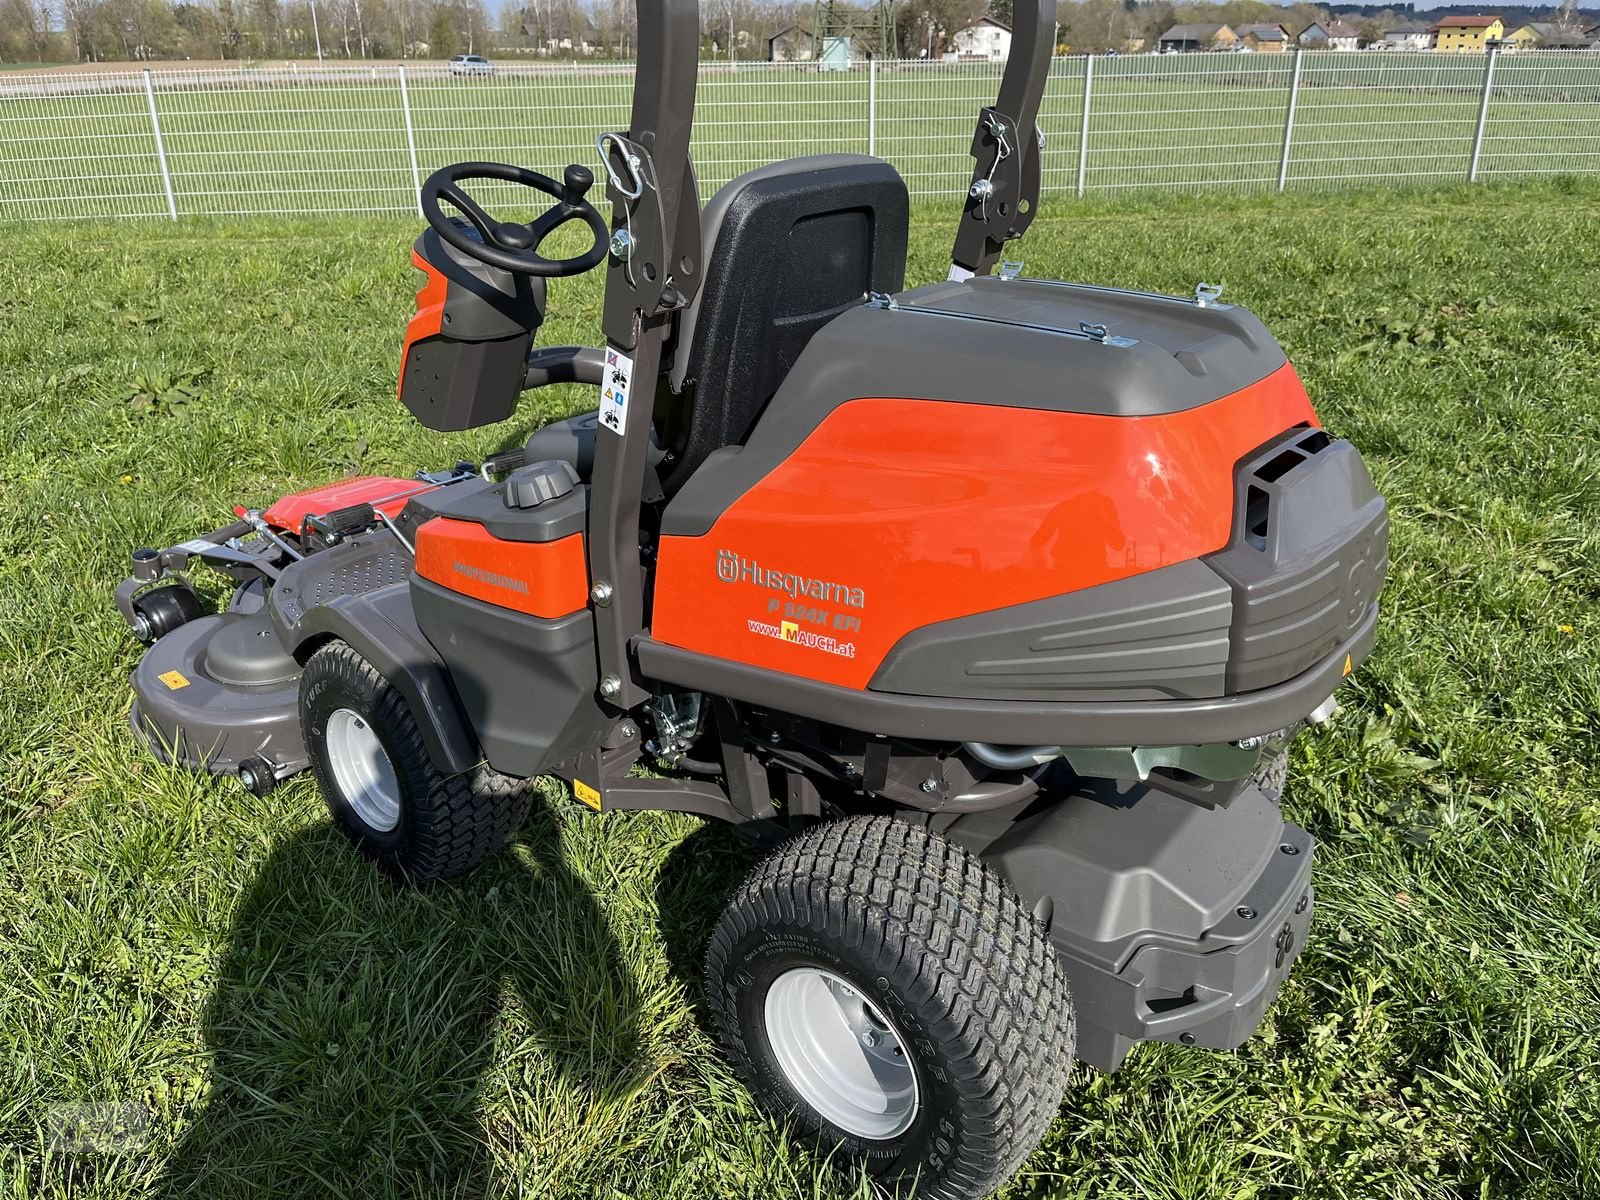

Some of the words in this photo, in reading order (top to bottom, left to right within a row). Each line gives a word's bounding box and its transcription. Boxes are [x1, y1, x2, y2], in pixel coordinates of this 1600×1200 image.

[453, 561, 528, 594] PROFESSIONAL
[740, 558, 864, 608] Husqvarna
[767, 598, 780, 613] P
[784, 602, 829, 625] 524X
[832, 613, 862, 633] EFI
